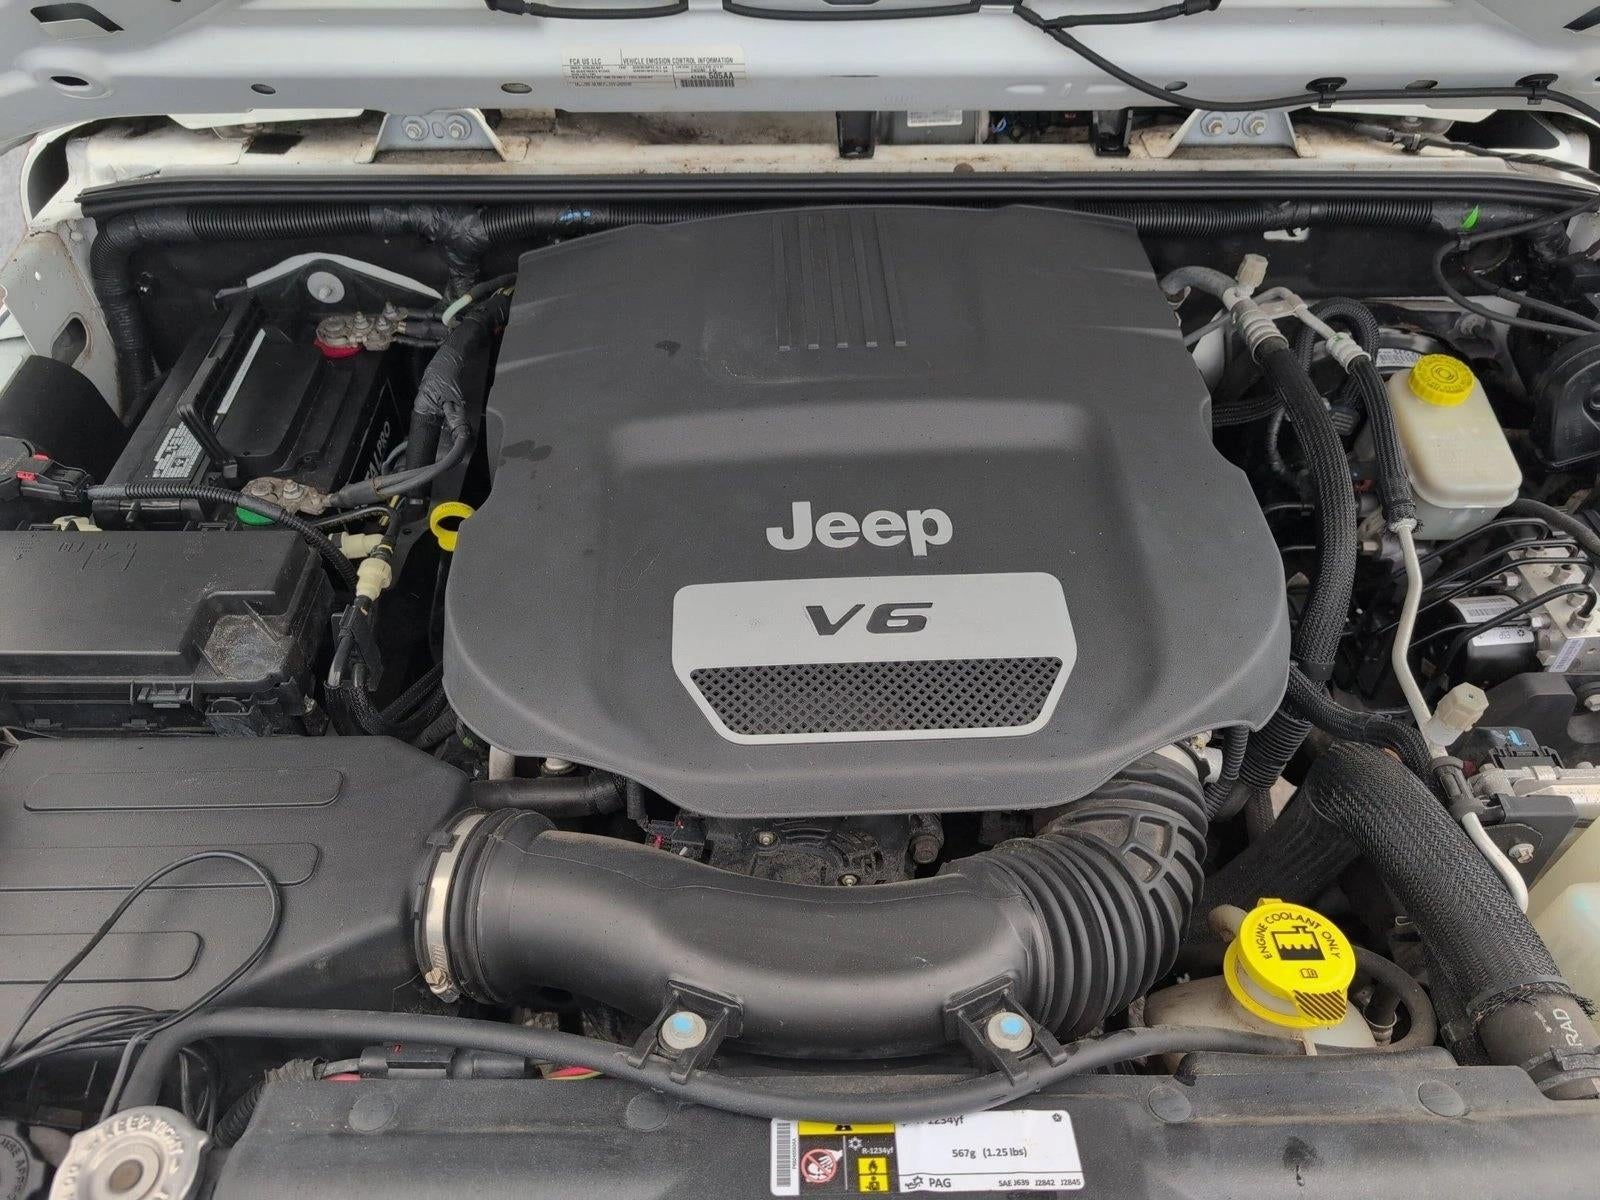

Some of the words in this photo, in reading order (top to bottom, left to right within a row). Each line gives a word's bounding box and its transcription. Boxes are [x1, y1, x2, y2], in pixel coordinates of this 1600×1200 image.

[623, 57, 644, 65] VEHICLE
[645, 57, 670, 65] EMISSION
[708, 71, 735, 80] 505AA
[766, 501, 953, 556] Jeep
[805, 602, 933, 635] V6
[1256, 922, 1273, 960] ENGINE
[1265, 911, 1321, 929] COOLANT
[1322, 931, 1341, 960] ONLY
[1552, 1008, 1583, 1048] RAD
[861, 1146, 894, 1156] R-1234yf
[952, 1149, 977, 1160] 567g
[982, 1147, 1009, 1159] (1.25
[1010, 1147, 1028, 1158] lbs)
[929, 1178, 952, 1189] PAG
[998, 1179, 1013, 1187] SAE
[1014, 1179, 1030, 1187] J639
[1035, 1179, 1056, 1187] J2842
[1060, 1178, 1082, 1187] J2845
